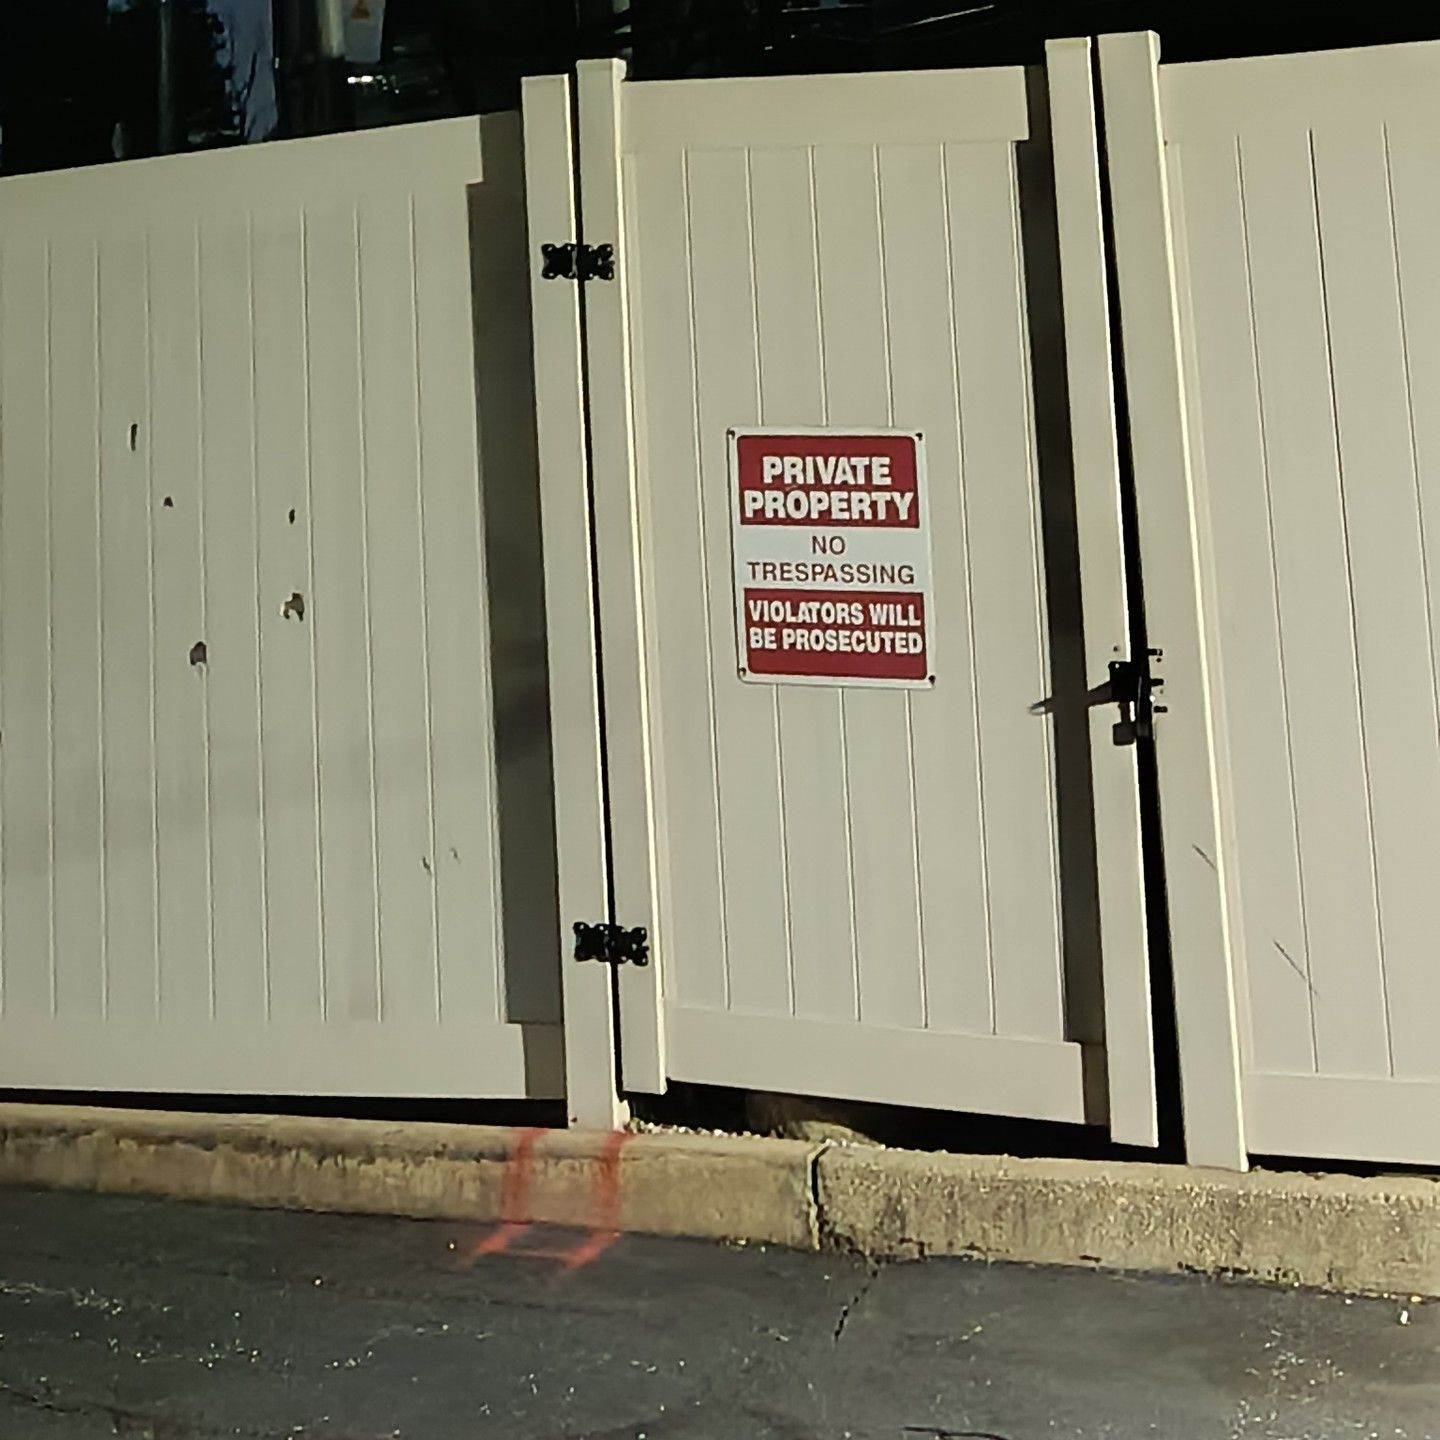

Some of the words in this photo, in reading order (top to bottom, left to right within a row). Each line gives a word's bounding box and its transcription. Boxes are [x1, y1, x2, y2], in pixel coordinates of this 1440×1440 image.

[762, 456, 892, 486] PRIVATE
[744, 491, 914, 521] PROPERTY
[812, 535, 846, 555] NO
[747, 561, 915, 585] TRESPASSING
[749, 600, 863, 625] VIOLATORS
[869, 604, 921, 627] WILL
[749, 627, 777, 650] BE
[782, 629, 923, 654] PROSECUTED
